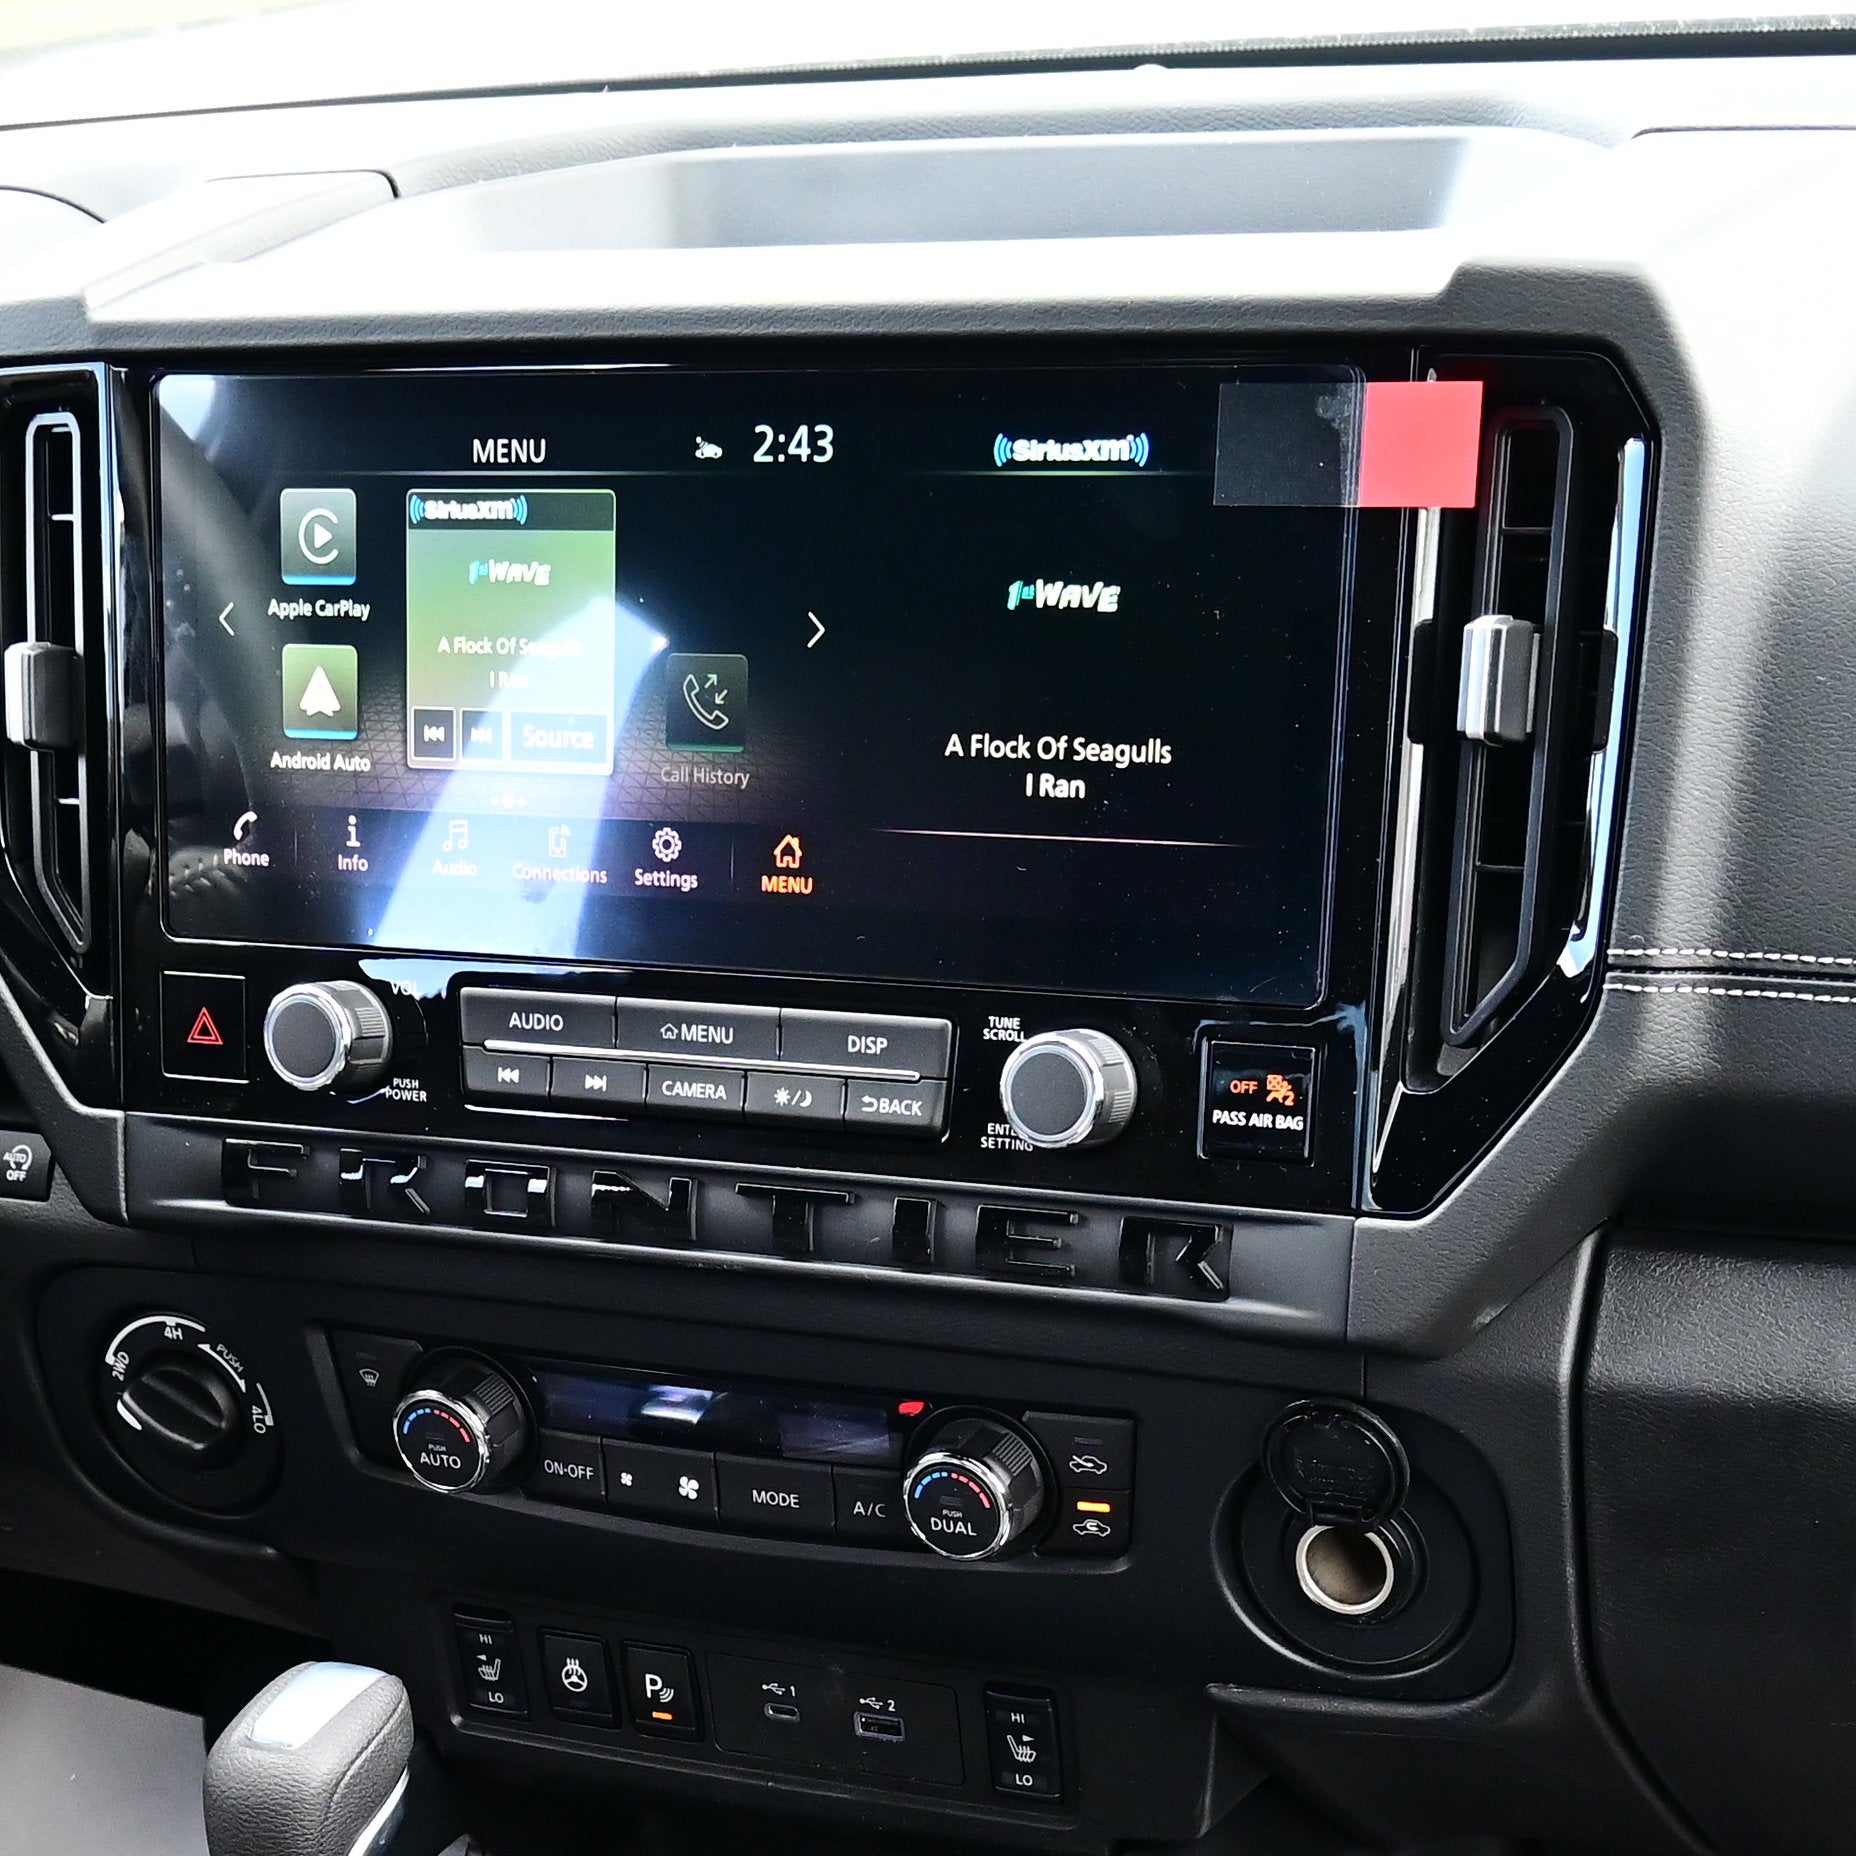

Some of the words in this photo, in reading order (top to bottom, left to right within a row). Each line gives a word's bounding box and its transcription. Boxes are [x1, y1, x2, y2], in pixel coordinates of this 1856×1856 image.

[472, 437, 547, 465] MENU
[752, 423, 835, 464] 2:43
[267, 598, 313, 620] Apple
[315, 599, 371, 622] CarPlay
[437, 635, 451, 655] A
[453, 635, 494, 656] Flock
[496, 637, 517, 656] Of
[522, 724, 596, 750] Source
[944, 733, 964, 758] A
[970, 733, 1032, 760] Flock
[1036, 735, 1069, 761] Of
[1072, 736, 1173, 769] Seagulls
[270, 751, 331, 771] Android
[333, 753, 372, 773] Auto
[660, 765, 690, 784] Call
[693, 767, 750, 790] History
[1026, 772, 1034, 797] I
[1038, 772, 1086, 799] Ran
[223, 847, 270, 868] Phone
[337, 853, 370, 873] Info
[431, 859, 478, 879] Audio
[511, 862, 608, 885] Connections
[634, 868, 699, 893] Settings
[760, 874, 814, 896] MENU
[508, 1011, 565, 1033] AUDIO
[987, 1015, 1022, 1030] TUNE
[680, 1022, 735, 1046] MENU
[982, 1027, 1028, 1043] SCROLL
[846, 1034, 889, 1056] DISP
[392, 1077, 420, 1090] PUSH
[660, 1079, 728, 1101] CAMERA
[1229, 1079, 1259, 1095] OFF
[384, 1087, 428, 1103] POWER
[878, 1096, 924, 1118] BACK
[1212, 1109, 1247, 1127] PASS
[1247, 1112, 1274, 1129] AIR
[1274, 1113, 1305, 1132] BAG
[980, 1136, 1034, 1152] SETTING
[2, 1151, 28, 1164] AUTO
[5, 1169, 27, 1182] OFF
[222, 1137, 1232, 1301] FRONTIER
[163, 1326, 184, 1341] 4H
[111, 1350, 131, 1382] 2WD
[215, 1343, 245, 1374] PUSH
[250, 1404, 267, 1435] 4LO
[419, 1451, 462, 1470] AUTO
[751, 1489, 801, 1509] MODE
[852, 1500, 887, 1518] A/C
[941, 1508, 964, 1519] PUSH
[929, 1516, 979, 1537] DUAL
[478, 1632, 494, 1646] HI
[644, 1672, 664, 1699] P
[487, 1690, 505, 1704] LO
[1010, 1711, 1026, 1725] HI
[1014, 1773, 1034, 1787] LO
